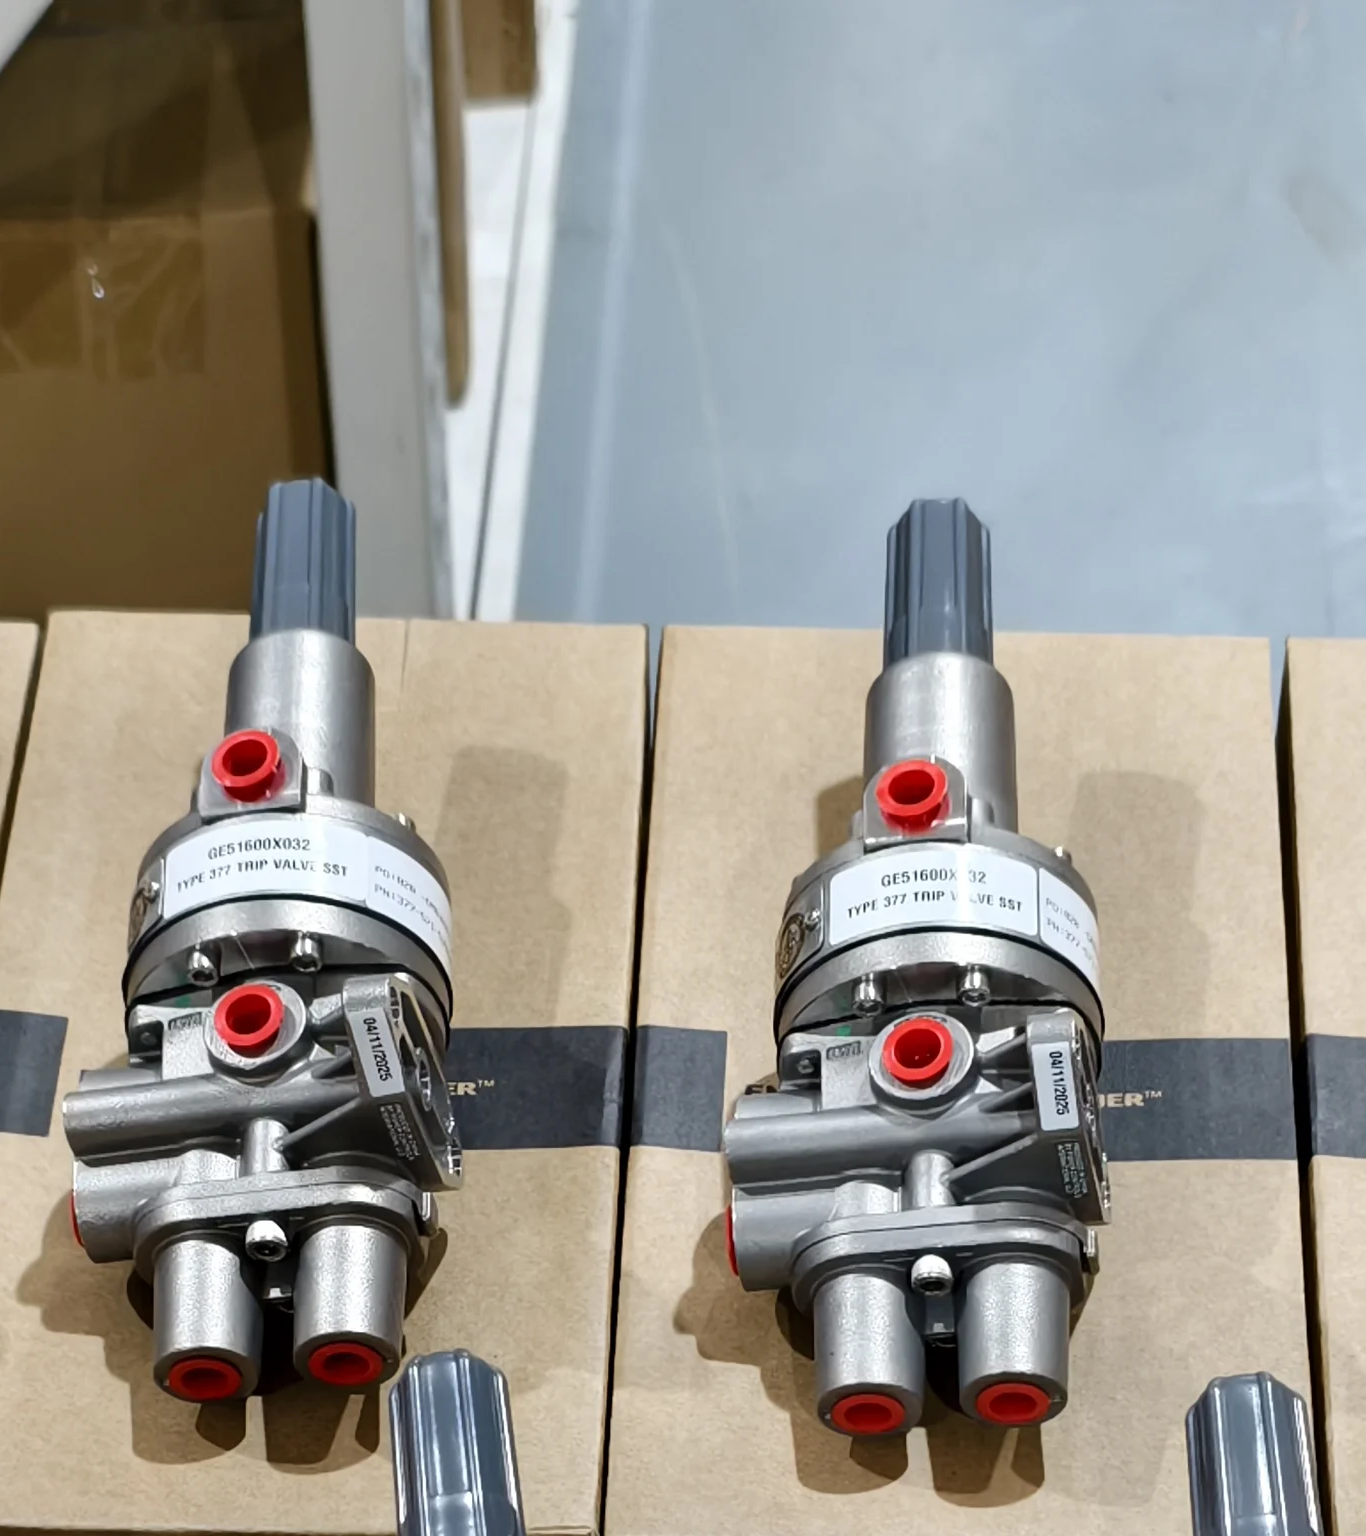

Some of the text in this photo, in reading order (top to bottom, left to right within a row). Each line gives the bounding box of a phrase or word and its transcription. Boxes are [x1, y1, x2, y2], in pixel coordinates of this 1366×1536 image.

[207, 837, 311, 861] GE51600X032
[176, 858, 349, 893] TYPE 377 TRIP VALVE SST
[880, 868, 987, 888] GE51600X32
[847, 890, 1023, 919] TYPE 377 TRIP VLVE SST
[363, 1017, 394, 1083] 04/11/2025
[1049, 1050, 1071, 1117] 04/11/2025
